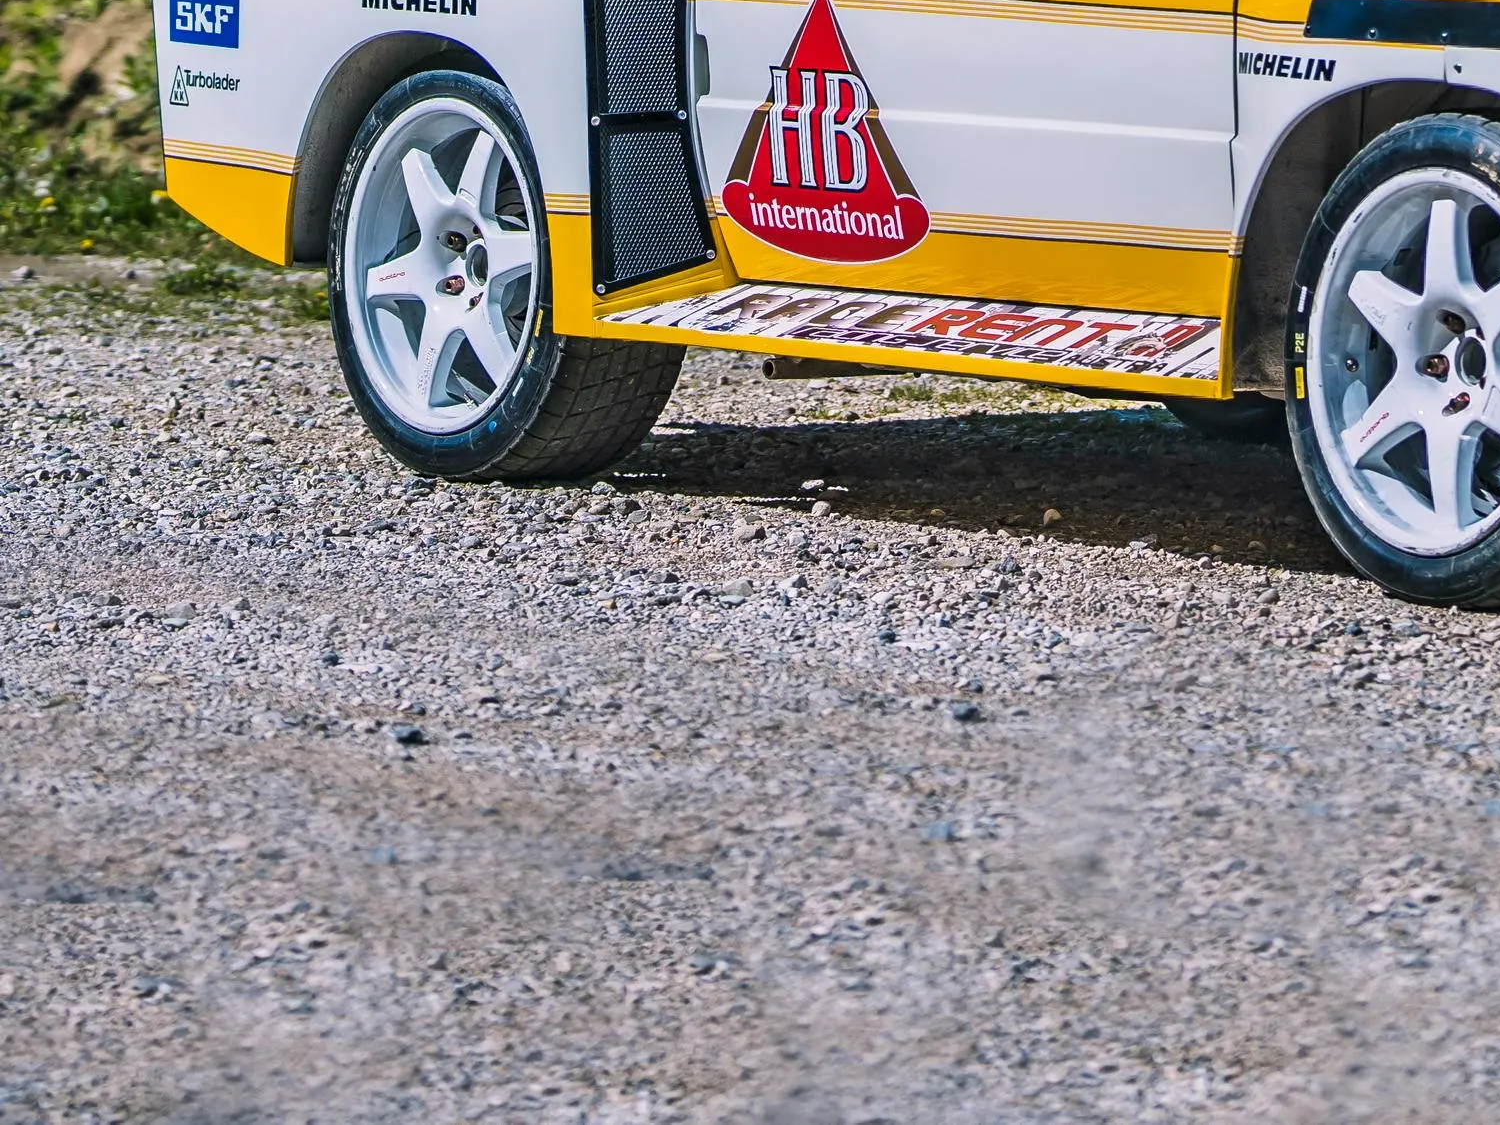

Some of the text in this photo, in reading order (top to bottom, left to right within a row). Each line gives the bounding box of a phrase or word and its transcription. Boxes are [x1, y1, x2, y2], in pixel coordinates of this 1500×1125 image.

[174, 0, 235, 35] SKF
[184, 70, 240, 91] Turbolader
[1238, 52, 1336, 82] MICHELIN
[768, 65, 870, 193] HB
[748, 193, 905, 241] international
